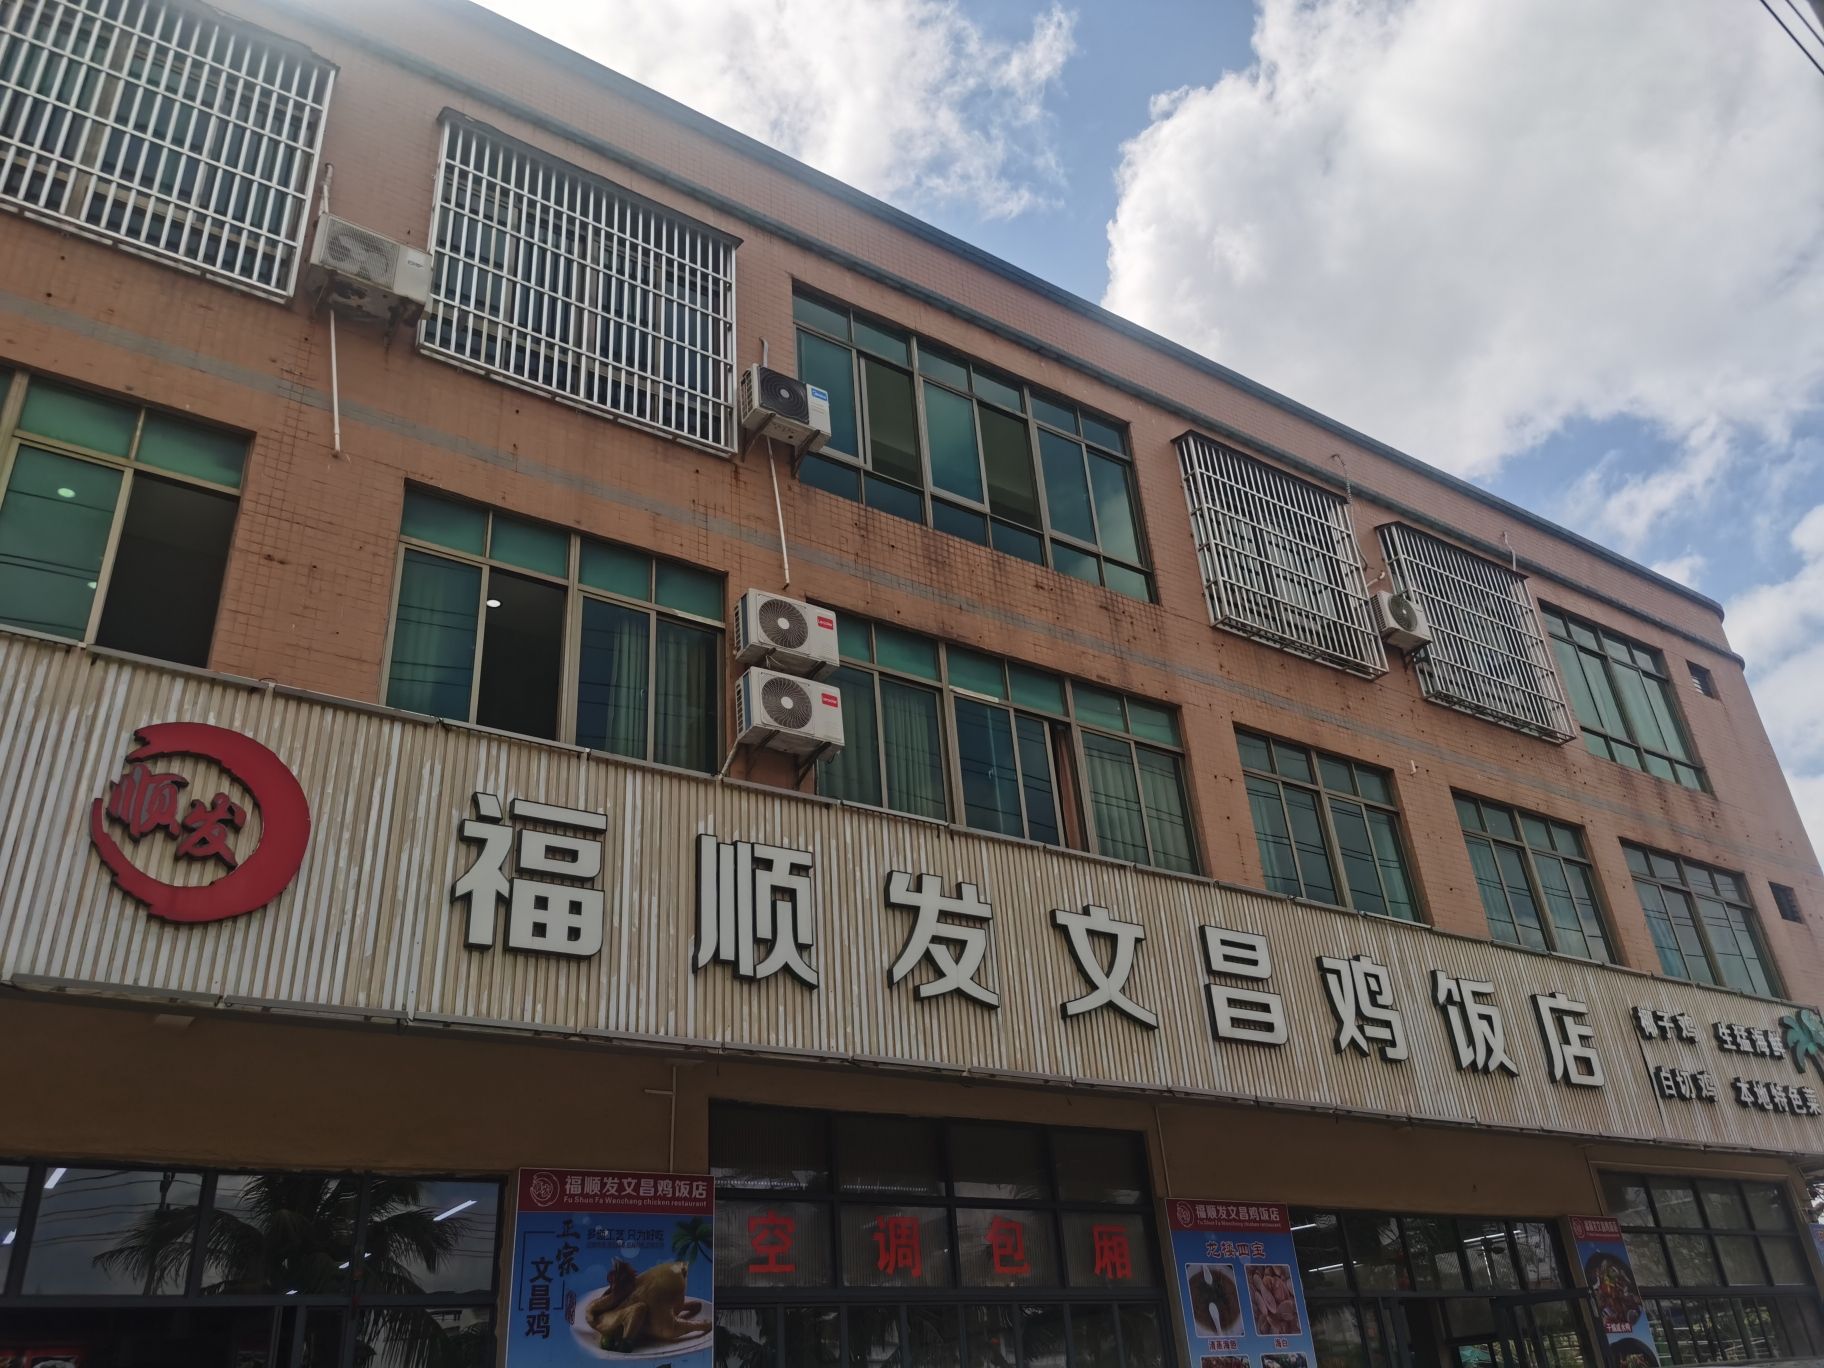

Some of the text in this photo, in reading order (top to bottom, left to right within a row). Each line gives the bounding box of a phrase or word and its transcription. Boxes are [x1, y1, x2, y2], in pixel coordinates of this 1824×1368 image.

[452, 791, 1604, 1087] 福顺发文昌鸡饭店
[1654, 1066, 1822, 1116] 白切鸡 本地特色菜
[565, 1175, 707, 1199] 福顺发文昌鸡饭店
[1196, 1204, 1280, 1221] 福顺发文昌鸡饭店
[748, 1210, 1132, 1280] 空调包厢
[525, 1256, 553, 1339] 文昌鸡
